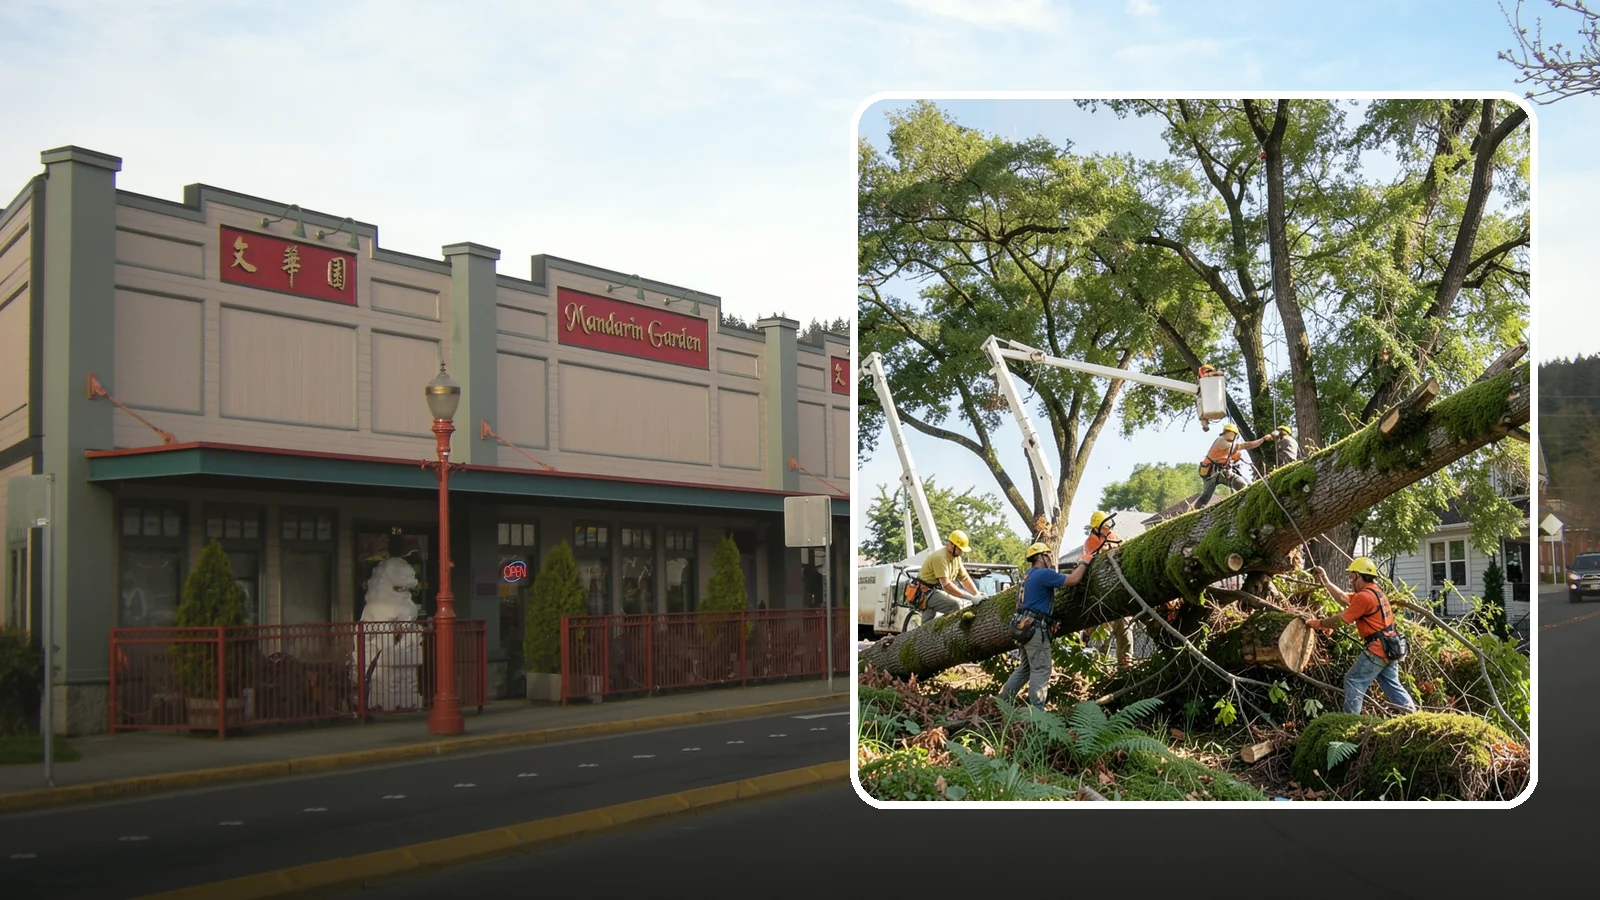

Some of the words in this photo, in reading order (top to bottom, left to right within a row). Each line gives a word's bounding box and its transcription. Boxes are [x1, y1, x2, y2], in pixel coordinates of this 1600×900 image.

[231, 236, 346, 290] 文華園
[565, 302, 643, 340] Mandarin
[648, 320, 701, 352] Garden
[503, 565, 527, 578] OPEN
